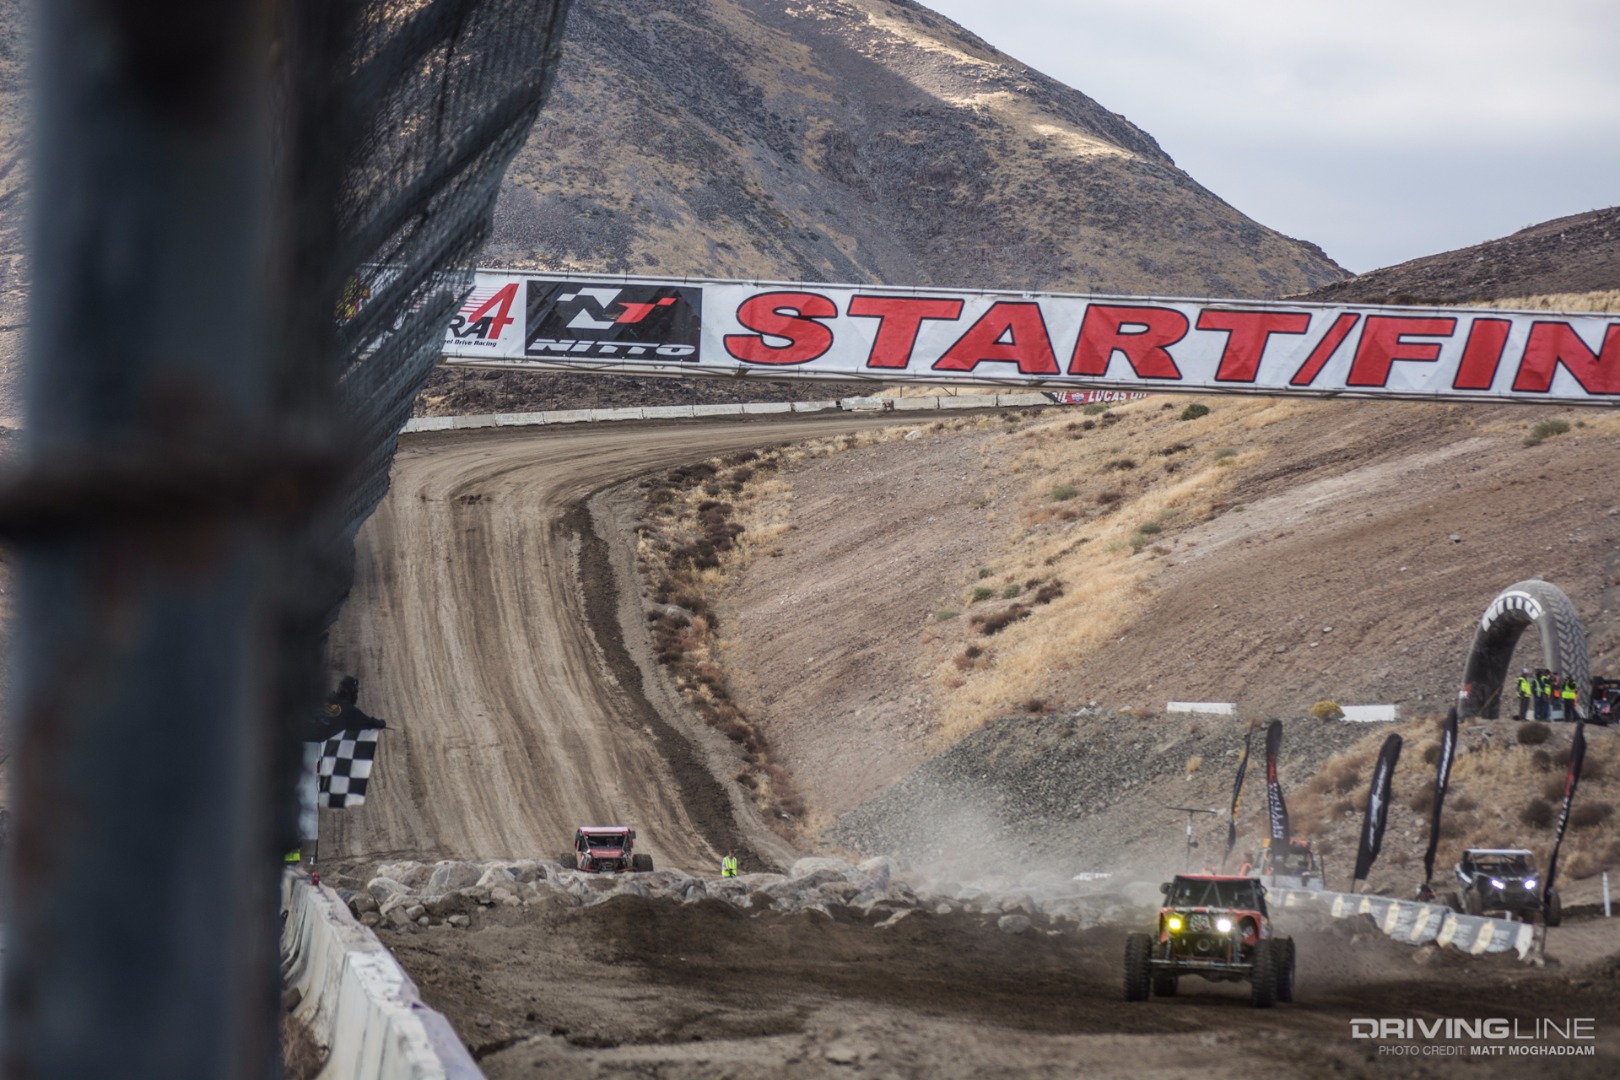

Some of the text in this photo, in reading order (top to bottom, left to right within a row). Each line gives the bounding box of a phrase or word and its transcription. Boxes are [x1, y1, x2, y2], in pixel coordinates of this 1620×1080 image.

[473, 340, 498, 348] Racing
[527, 338, 696, 356] NITTO
[1088, 390, 1127, 403] LUCAS
